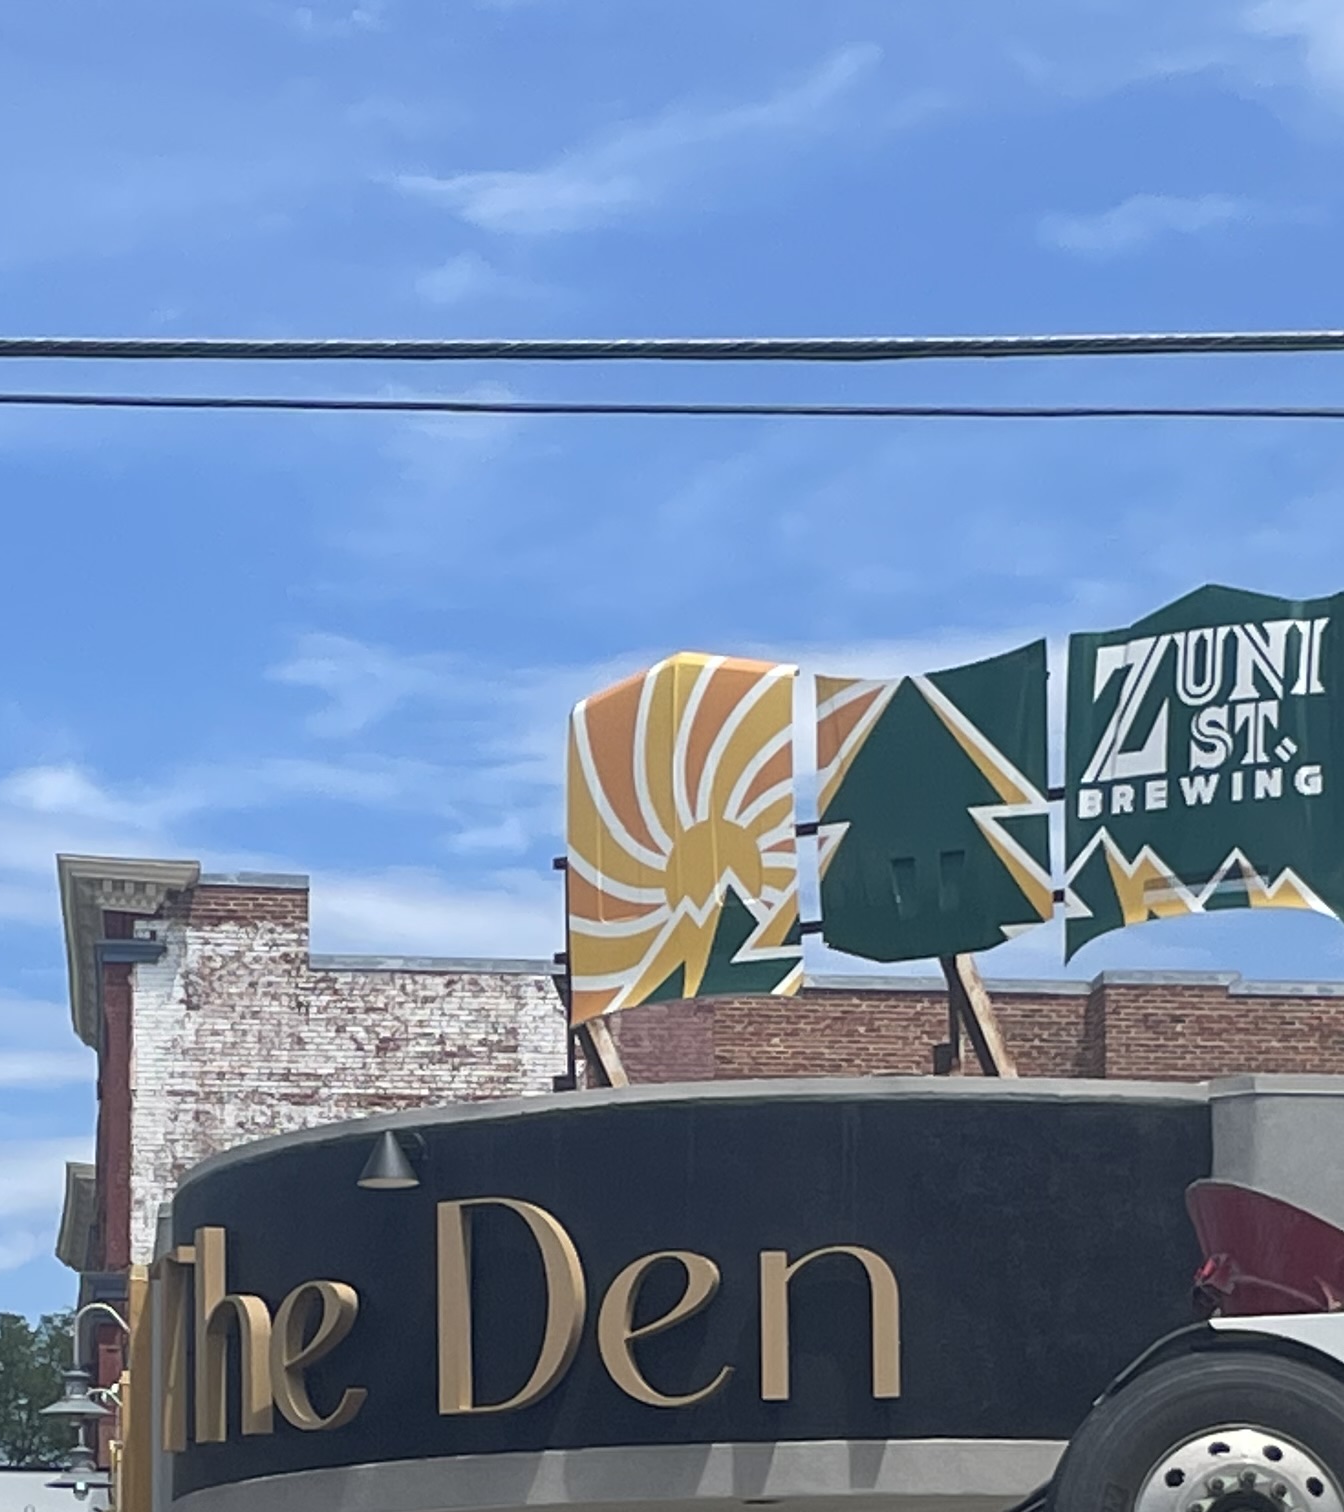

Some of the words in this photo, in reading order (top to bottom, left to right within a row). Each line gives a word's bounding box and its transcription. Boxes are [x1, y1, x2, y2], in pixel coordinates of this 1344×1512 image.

[1081, 617, 1330, 783] ZUNI
[1190, 699, 1298, 773] ST.
[1077, 765, 1323, 819] BREWING
[437, 1197, 901, 1414] Den
